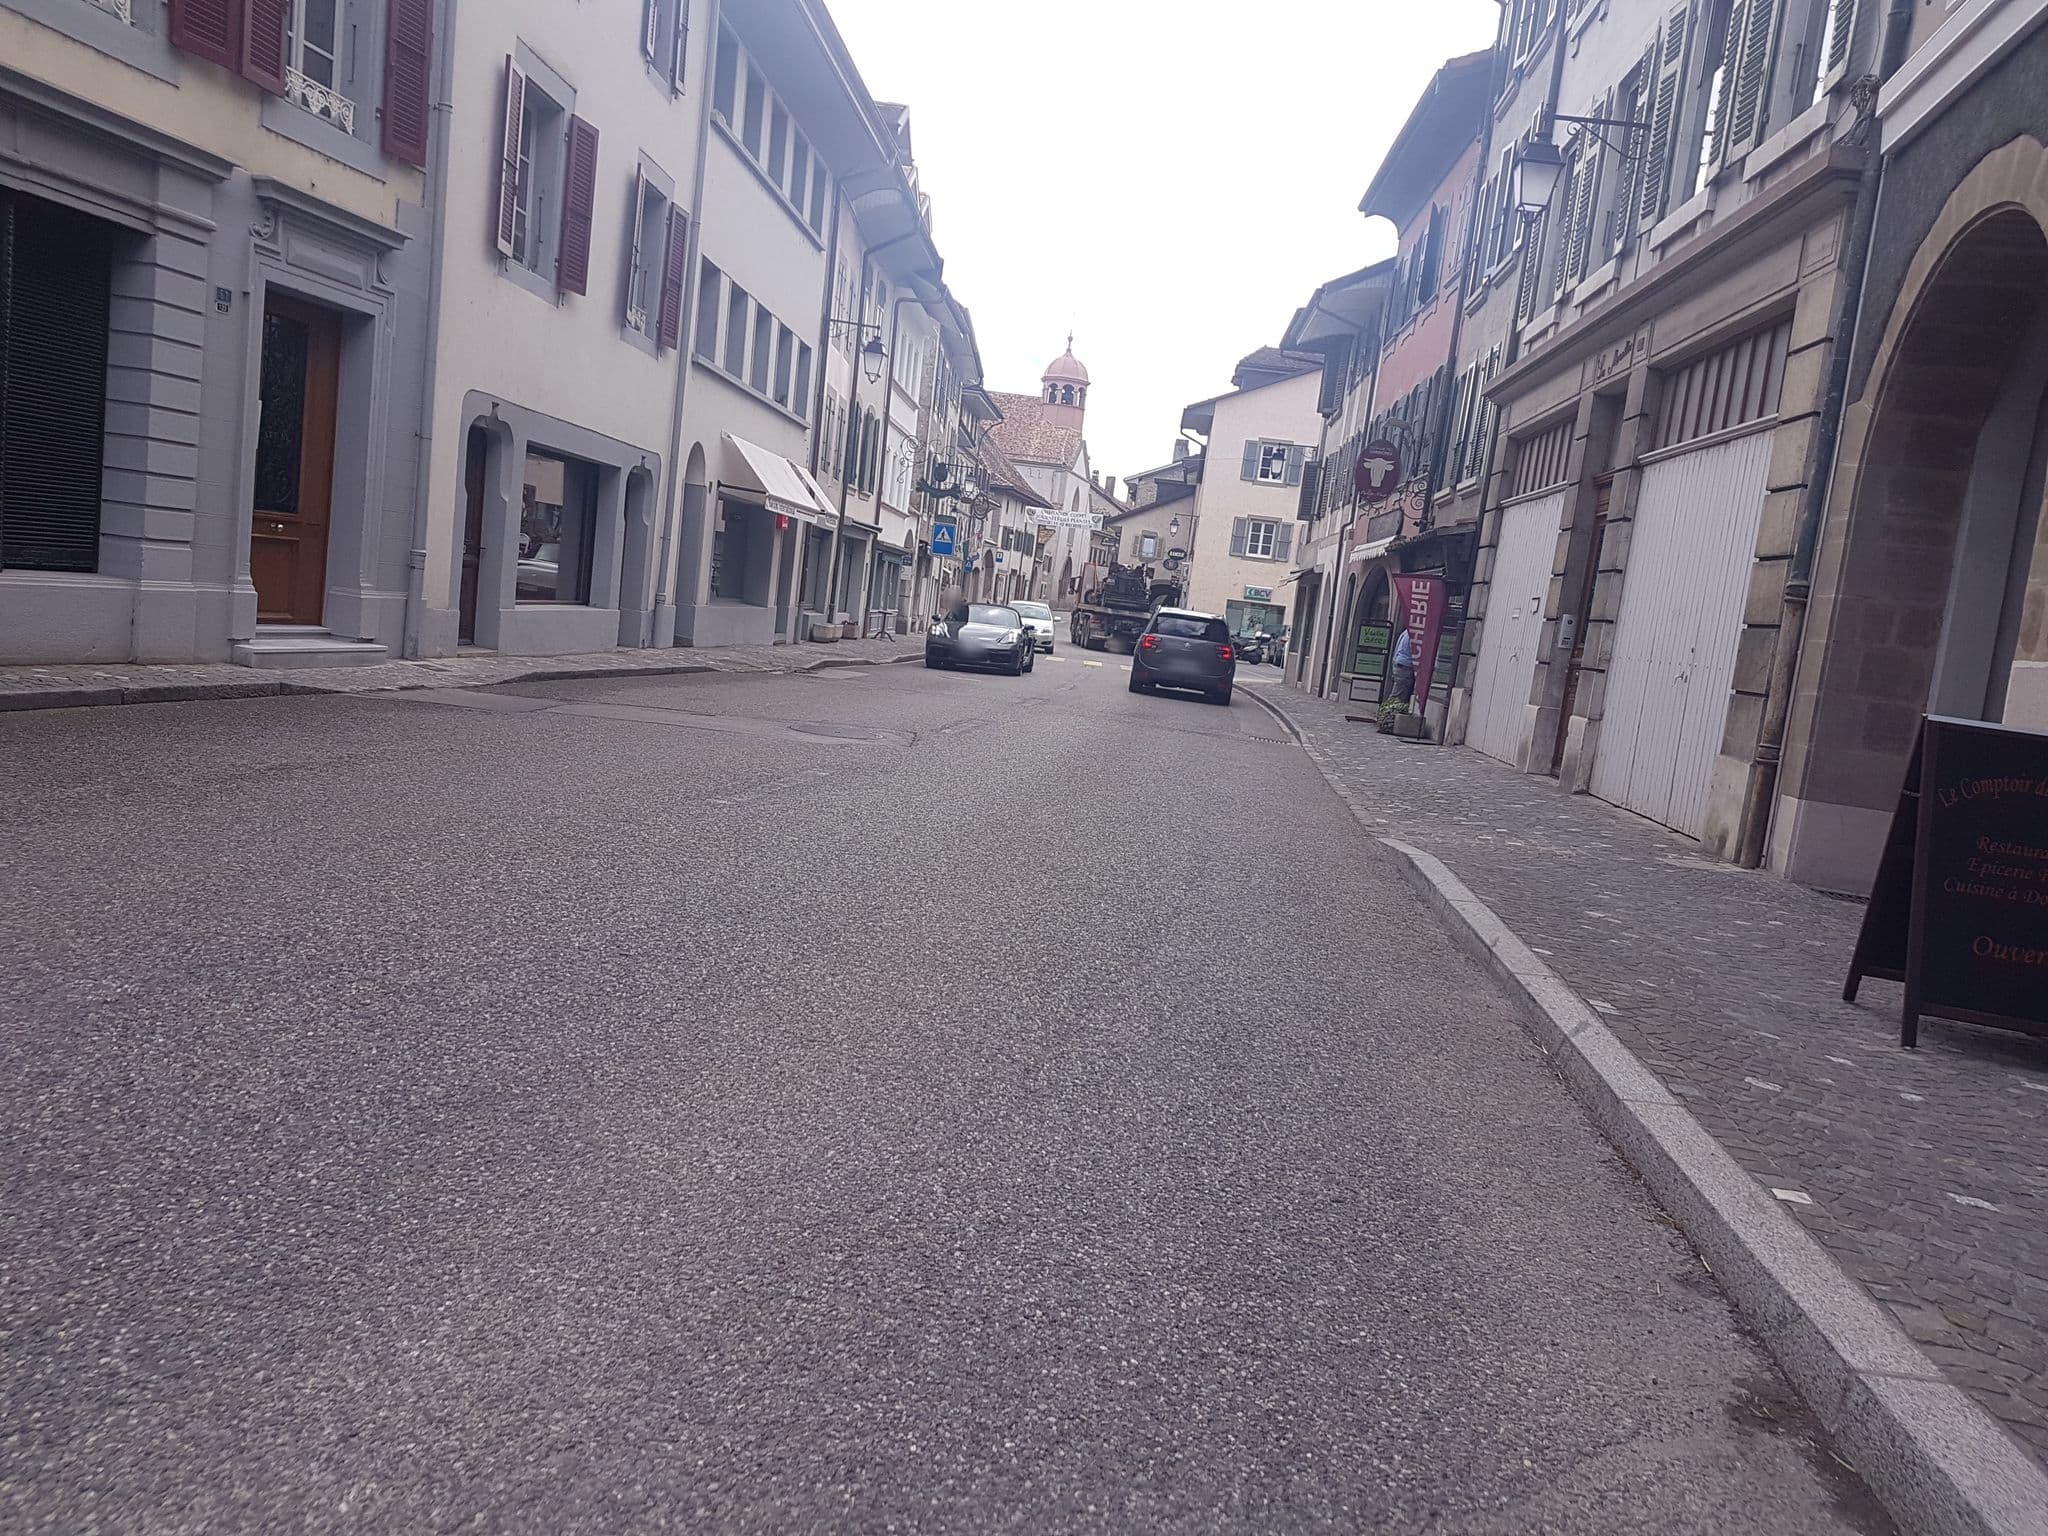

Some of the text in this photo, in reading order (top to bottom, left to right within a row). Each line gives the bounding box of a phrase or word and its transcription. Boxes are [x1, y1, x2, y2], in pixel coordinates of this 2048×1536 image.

[1254, 589, 1271, 597] BCV
[1937, 776, 2048, 808] Le Comptoir d
[1943, 878, 2005, 897] Cuisine
